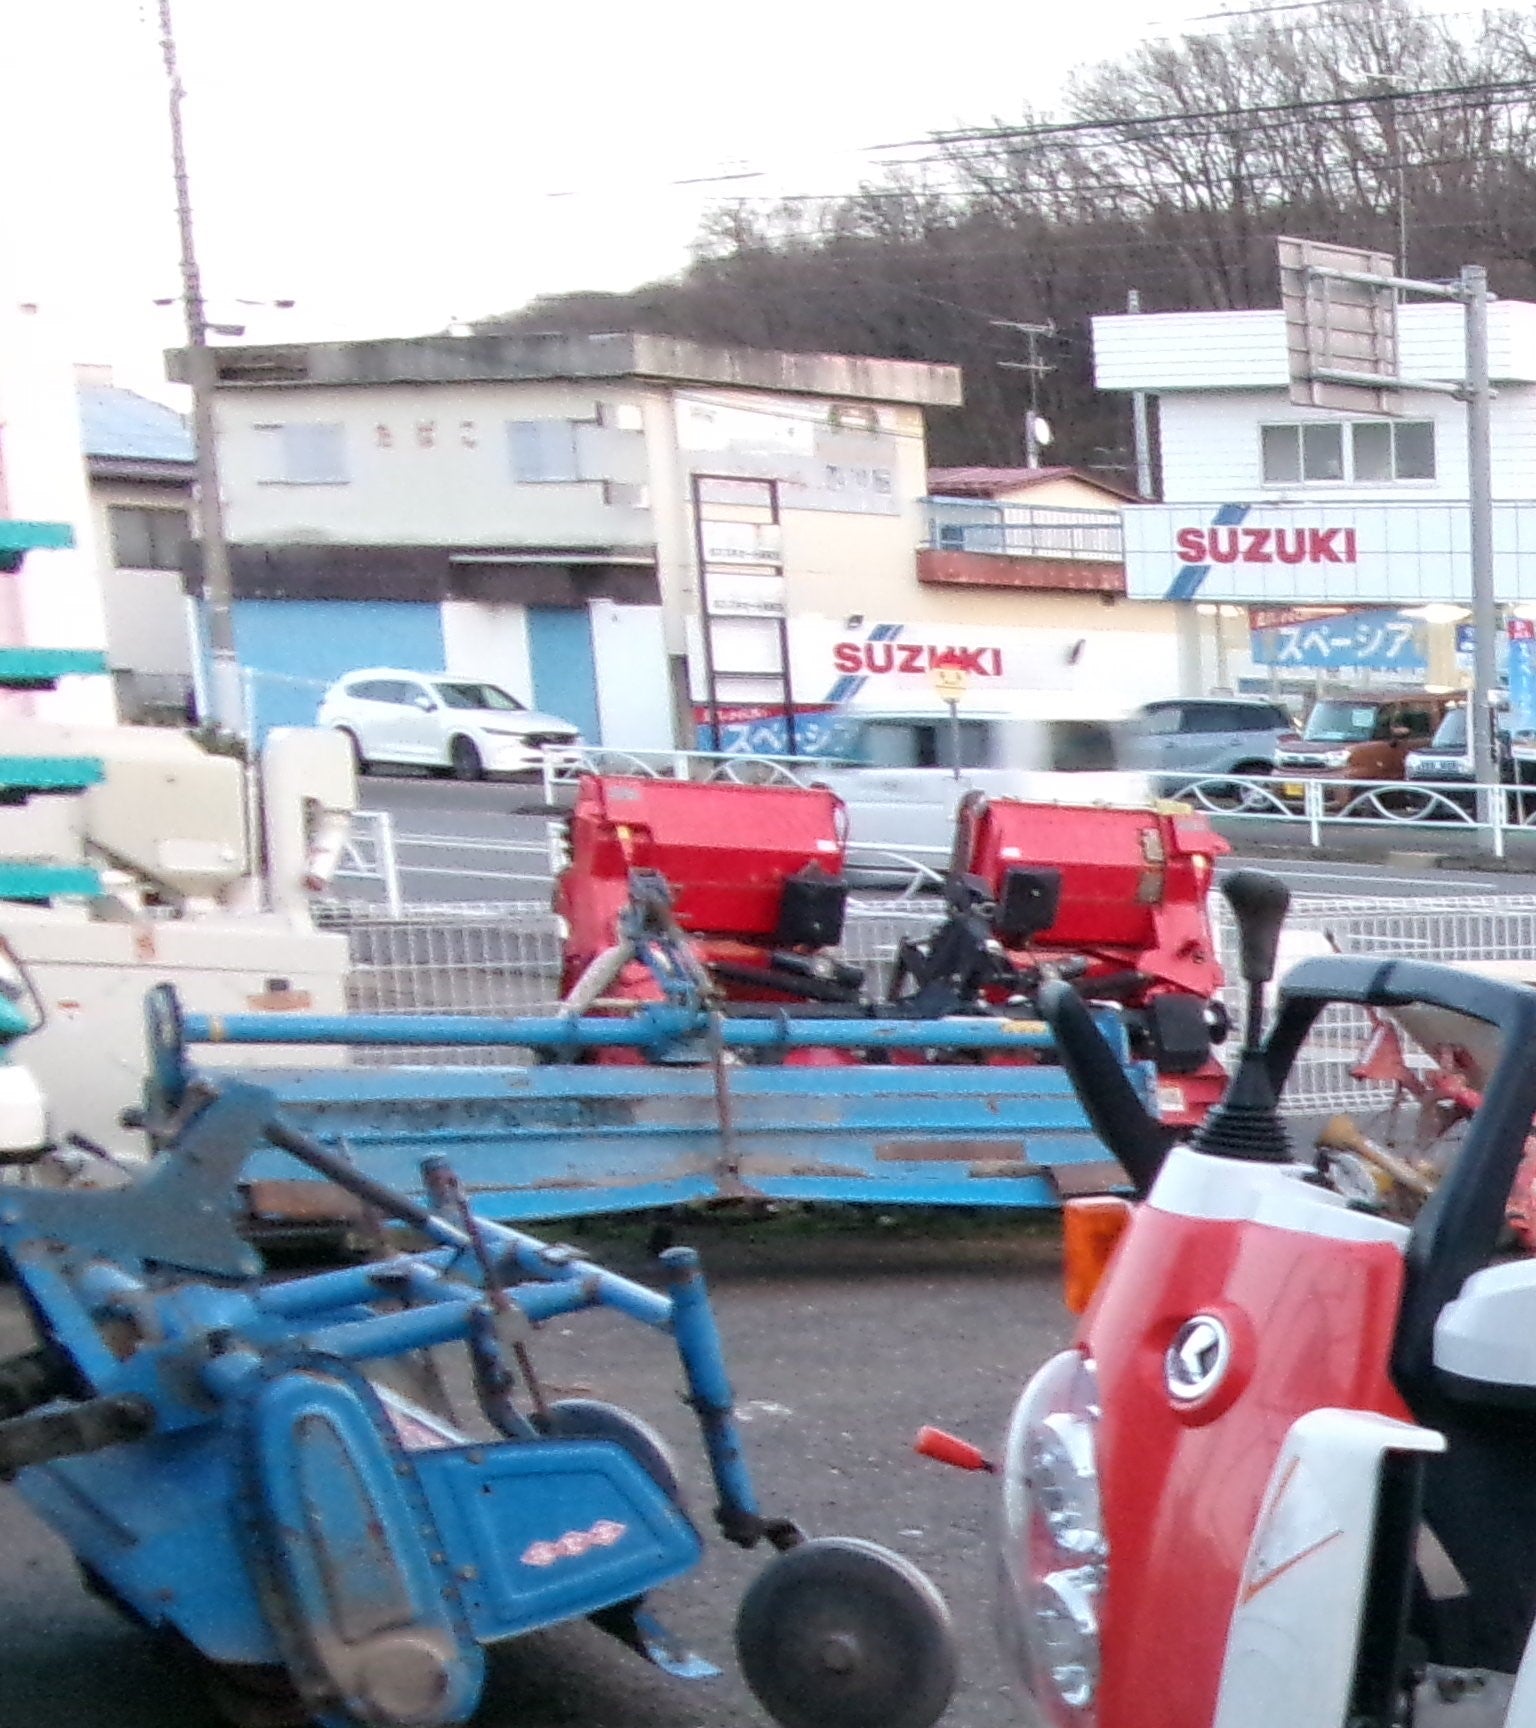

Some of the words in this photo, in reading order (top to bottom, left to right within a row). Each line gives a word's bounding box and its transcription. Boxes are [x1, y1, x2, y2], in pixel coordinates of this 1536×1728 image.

[1176, 526, 1357, 565] SUZUKI
[1277, 621, 1414, 661] スペーシア
